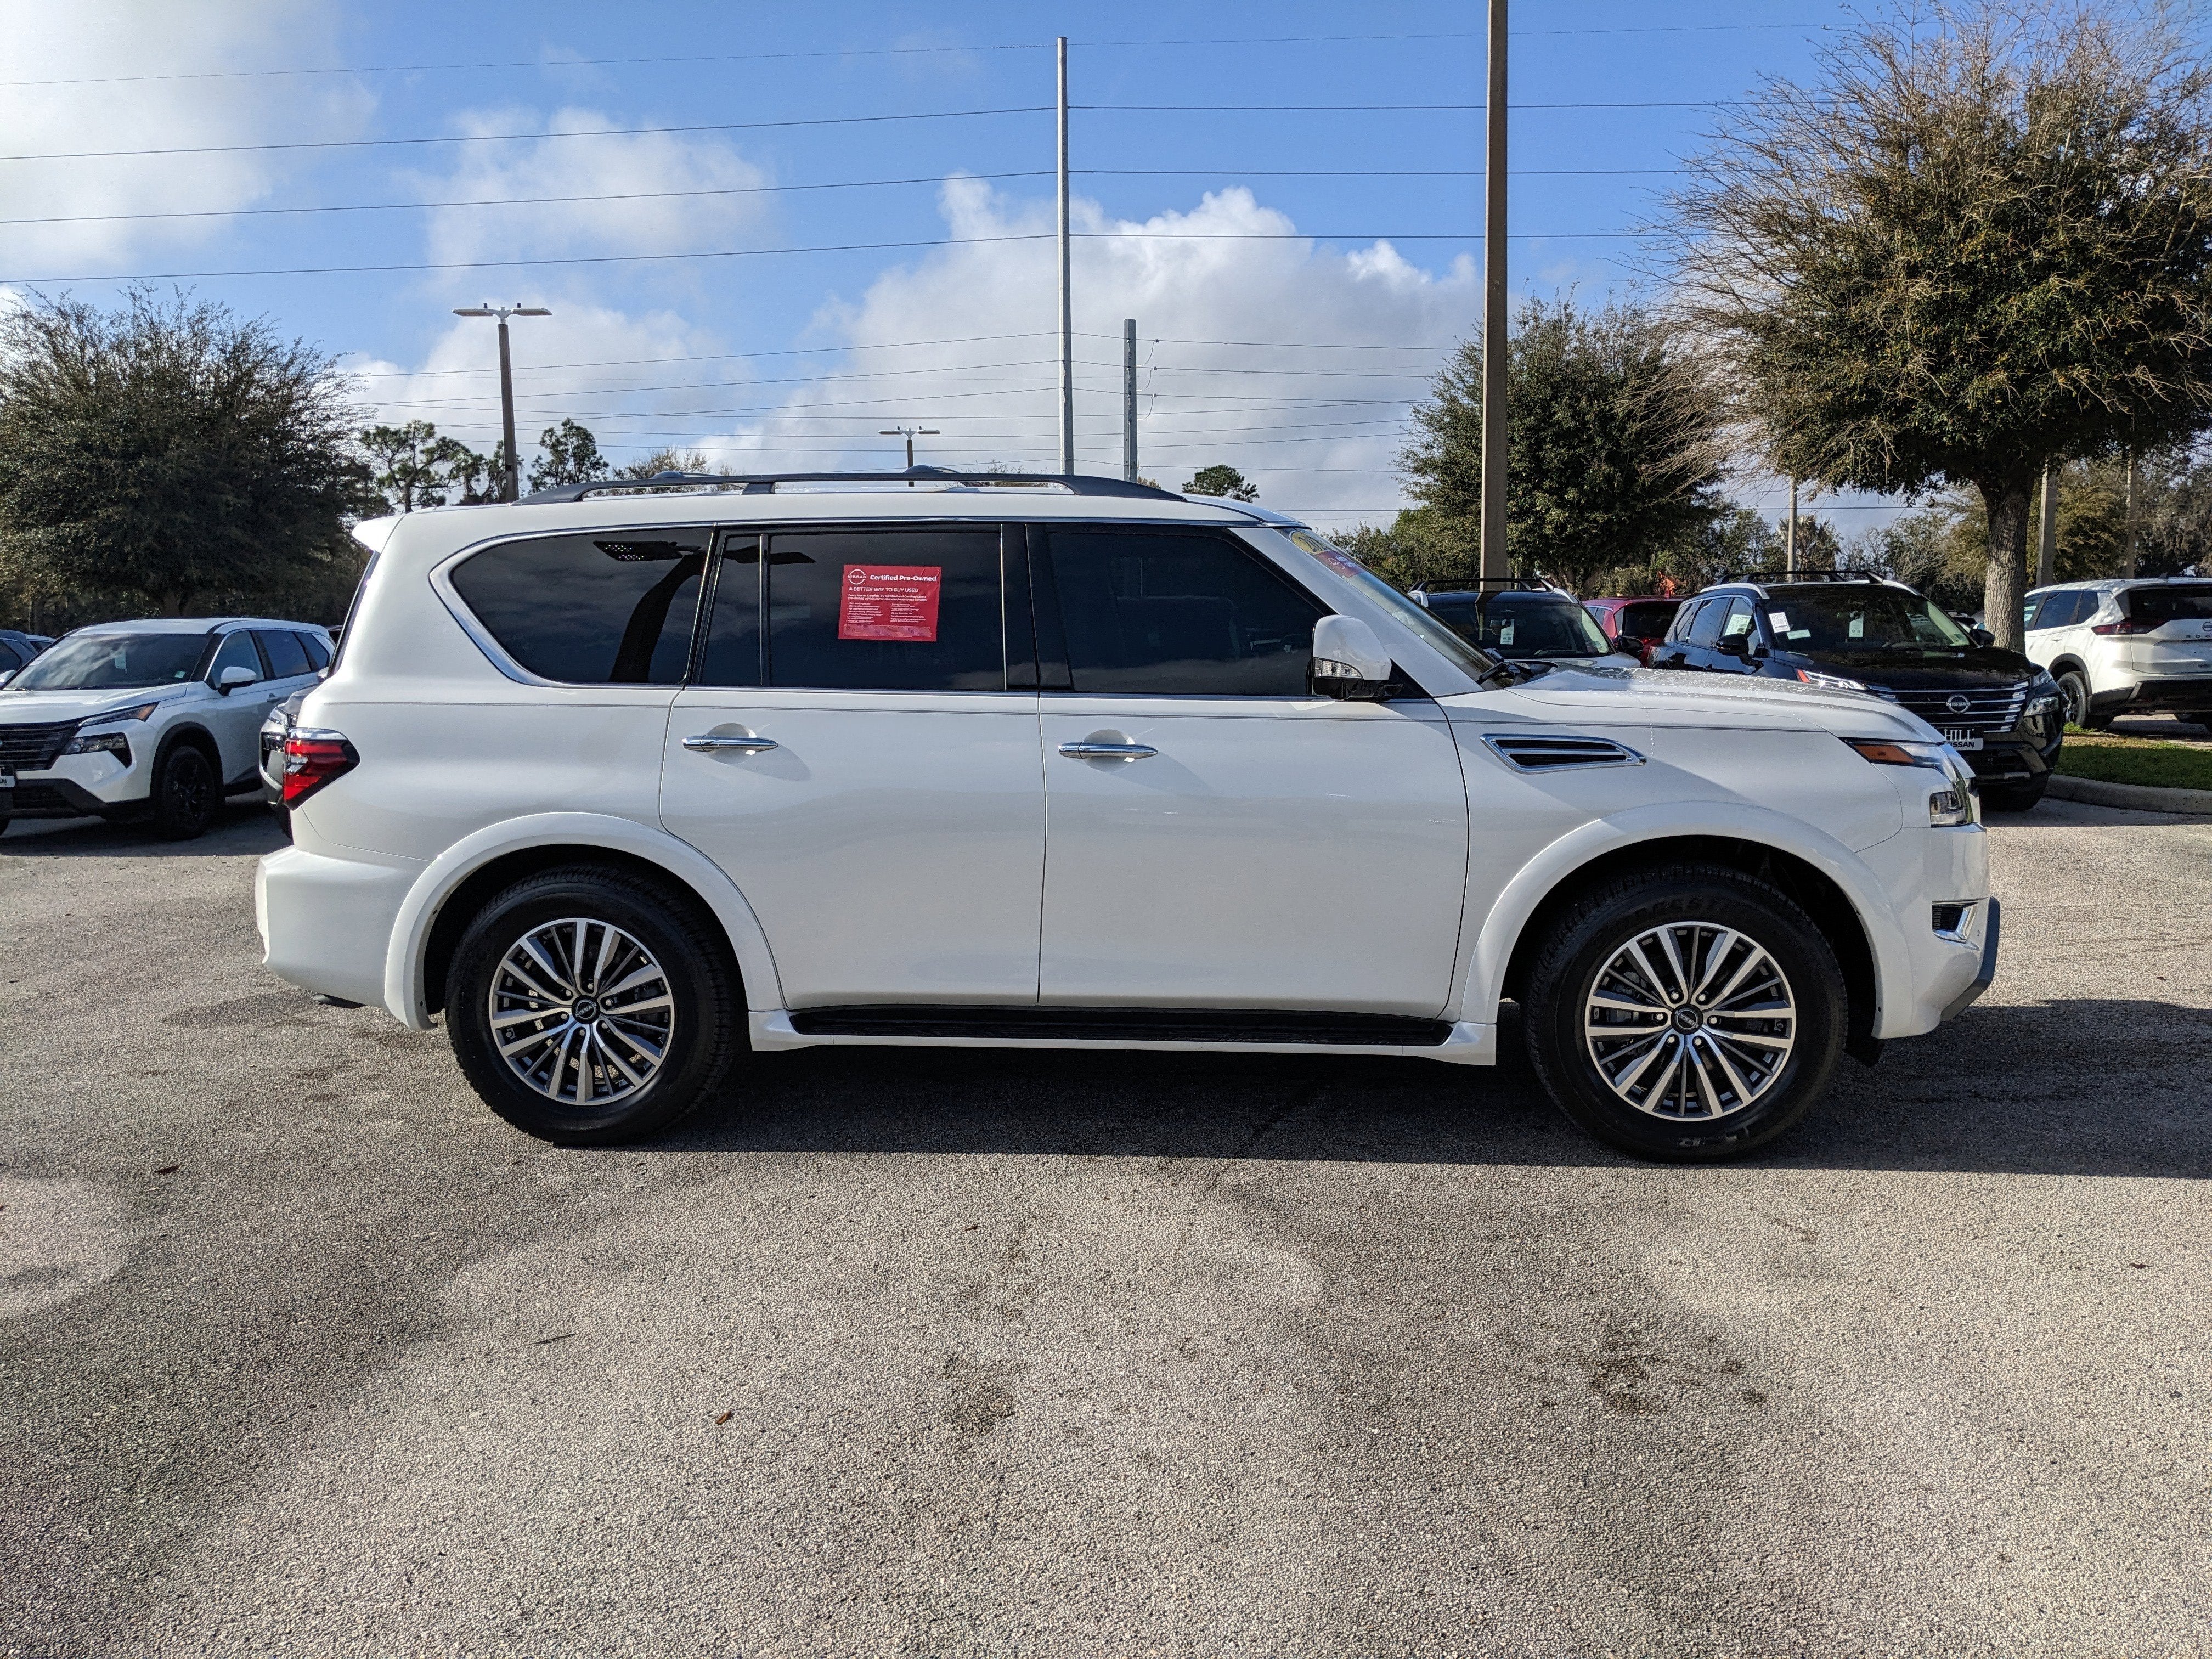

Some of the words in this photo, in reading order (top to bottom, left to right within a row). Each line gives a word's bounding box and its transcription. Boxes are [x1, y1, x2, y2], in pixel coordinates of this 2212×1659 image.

[1944, 729, 1974, 741] HILL
[575, 1002, 597, 1017] NISSAN
[1674, 1009, 1700, 1029] NISSAN
